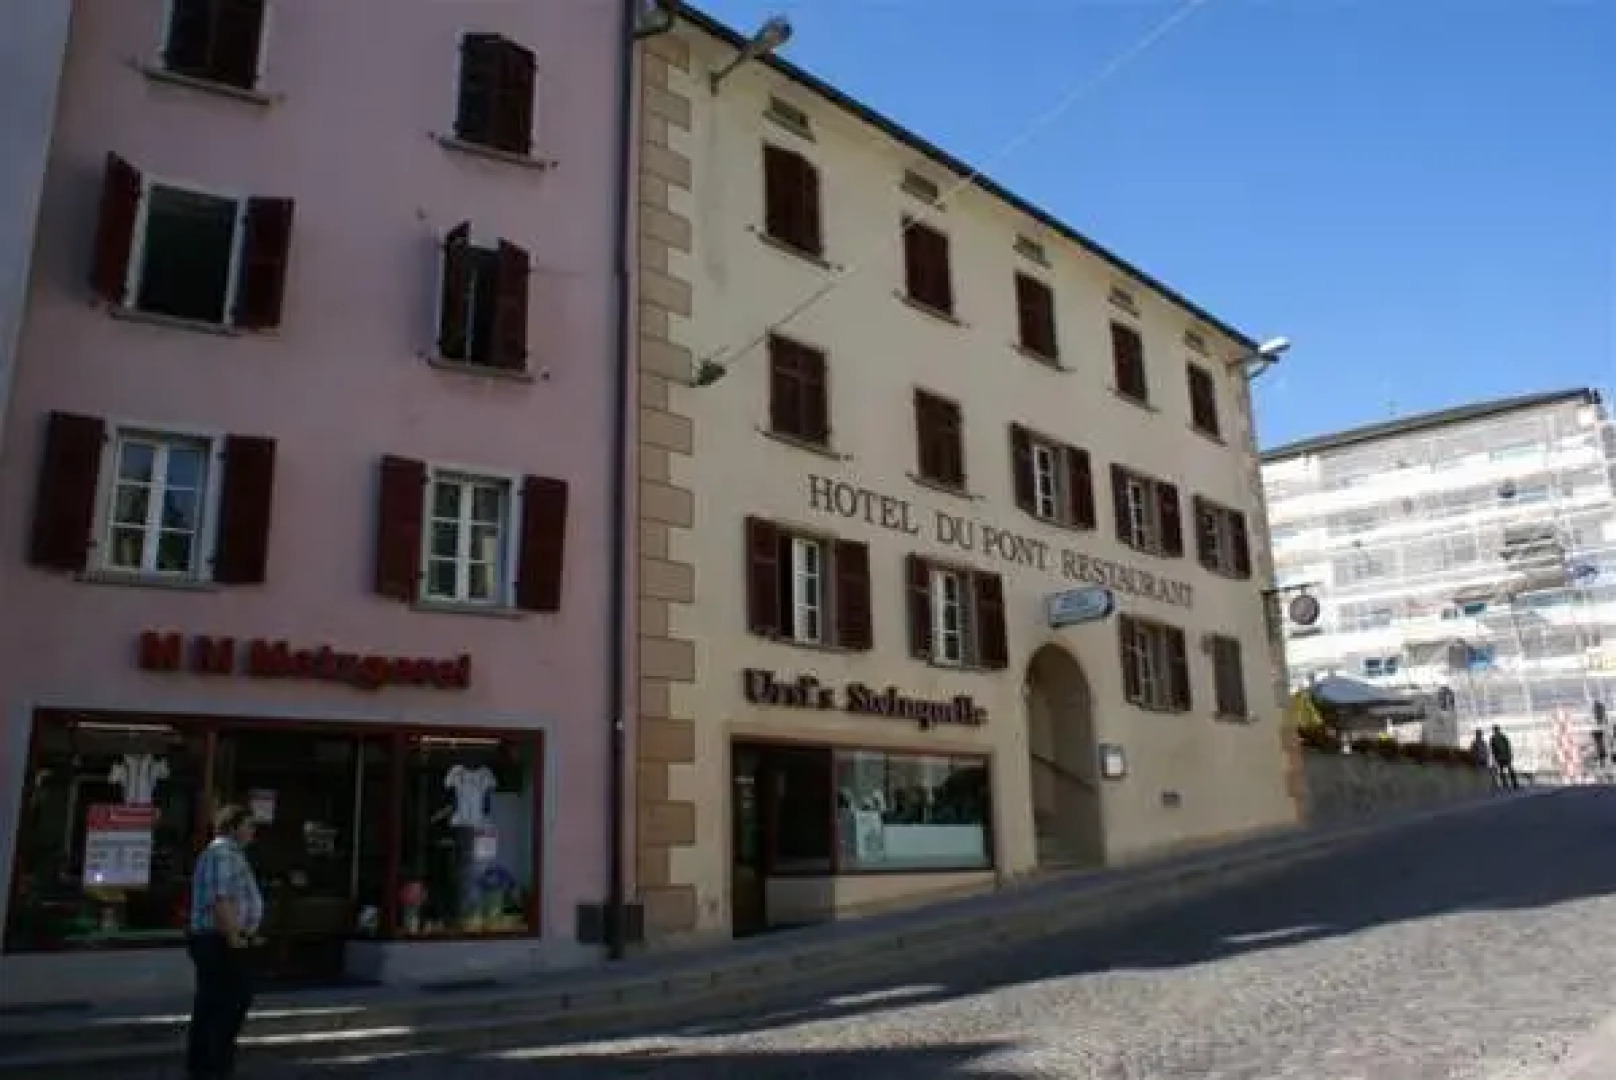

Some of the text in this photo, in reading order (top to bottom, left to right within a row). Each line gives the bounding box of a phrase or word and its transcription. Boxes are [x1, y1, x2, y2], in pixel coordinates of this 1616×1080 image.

[808, 475, 918, 534] HOTEL
[936, 510, 974, 550] DU
[982, 525, 1048, 571] PONT
